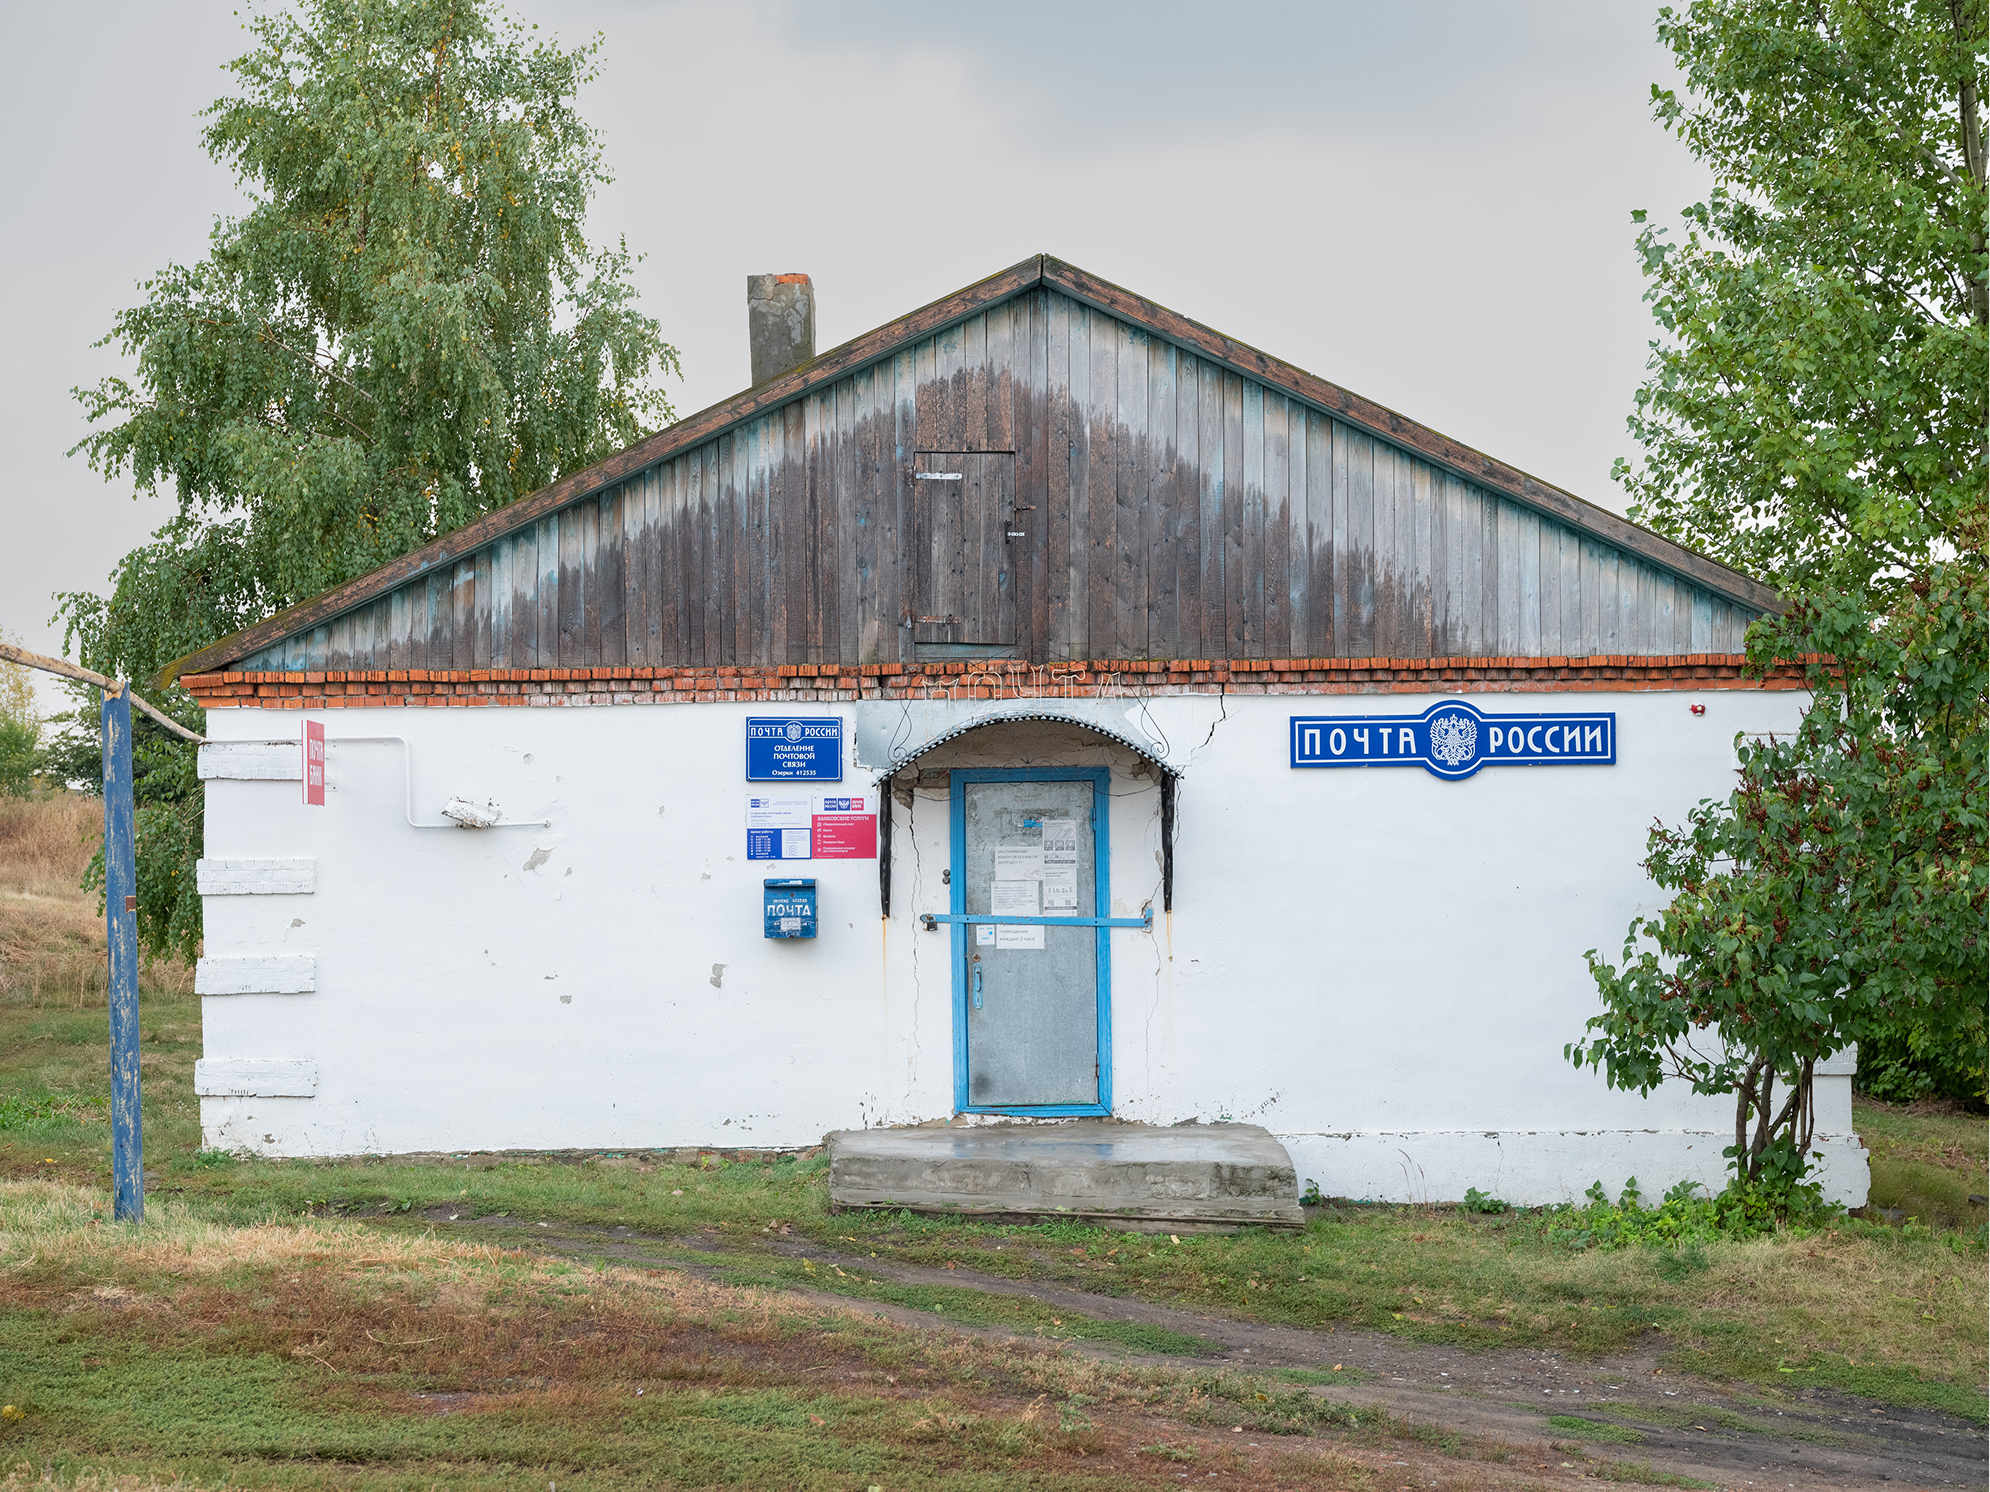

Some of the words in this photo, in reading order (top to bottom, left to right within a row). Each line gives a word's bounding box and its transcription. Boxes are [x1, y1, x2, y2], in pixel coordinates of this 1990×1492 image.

[750, 727, 783, 737] ПОЧТА
[804, 727, 838, 737] РОССИИ
[1304, 727, 1417, 755] ПОЧТА
[1489, 725, 1603, 754] РОССИИ
[309, 738, 324, 762] ПОЧТА
[773, 752, 815, 760] ПОЧТОВОЙ
[309, 764, 323, 787] БАНК
[772, 769, 794, 777] Озерки
[767, 904, 811, 916] ПОЧТА
